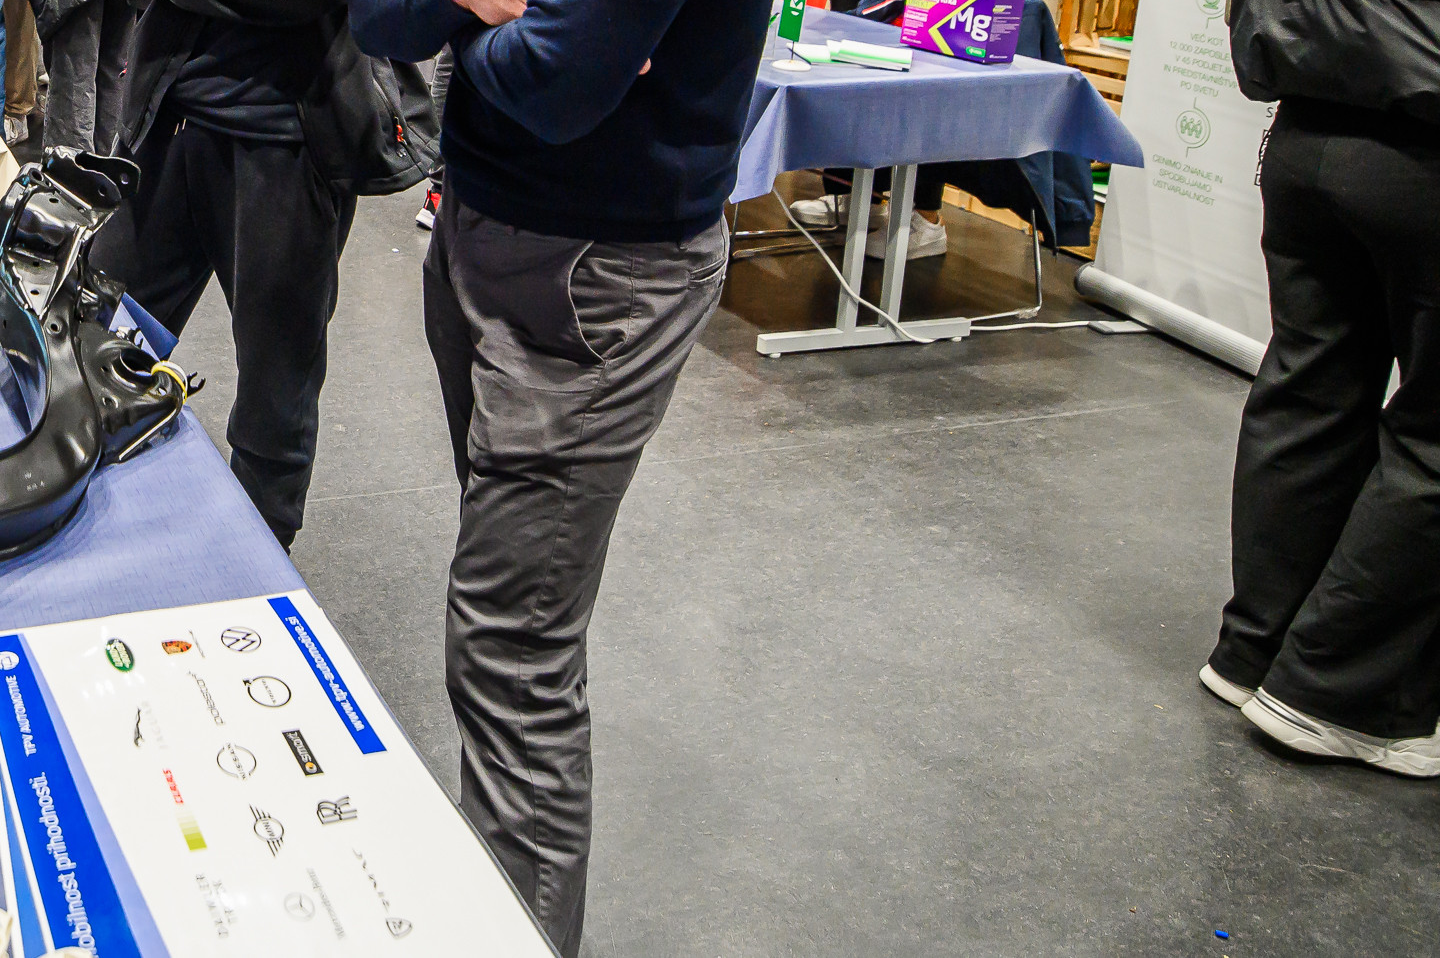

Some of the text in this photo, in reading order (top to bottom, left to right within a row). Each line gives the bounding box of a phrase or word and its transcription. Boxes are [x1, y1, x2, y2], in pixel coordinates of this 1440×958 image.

[949, 6, 992, 42] Mg
[284, 615, 365, 732] www.tpv-automotive.si
[5, 674, 37, 758] TPV AUTOMOTIVE
[227, 743, 247, 780] NISSAN
[286, 732, 313, 764] smart
[29, 771, 101, 958] obilnost prihodnosti.
